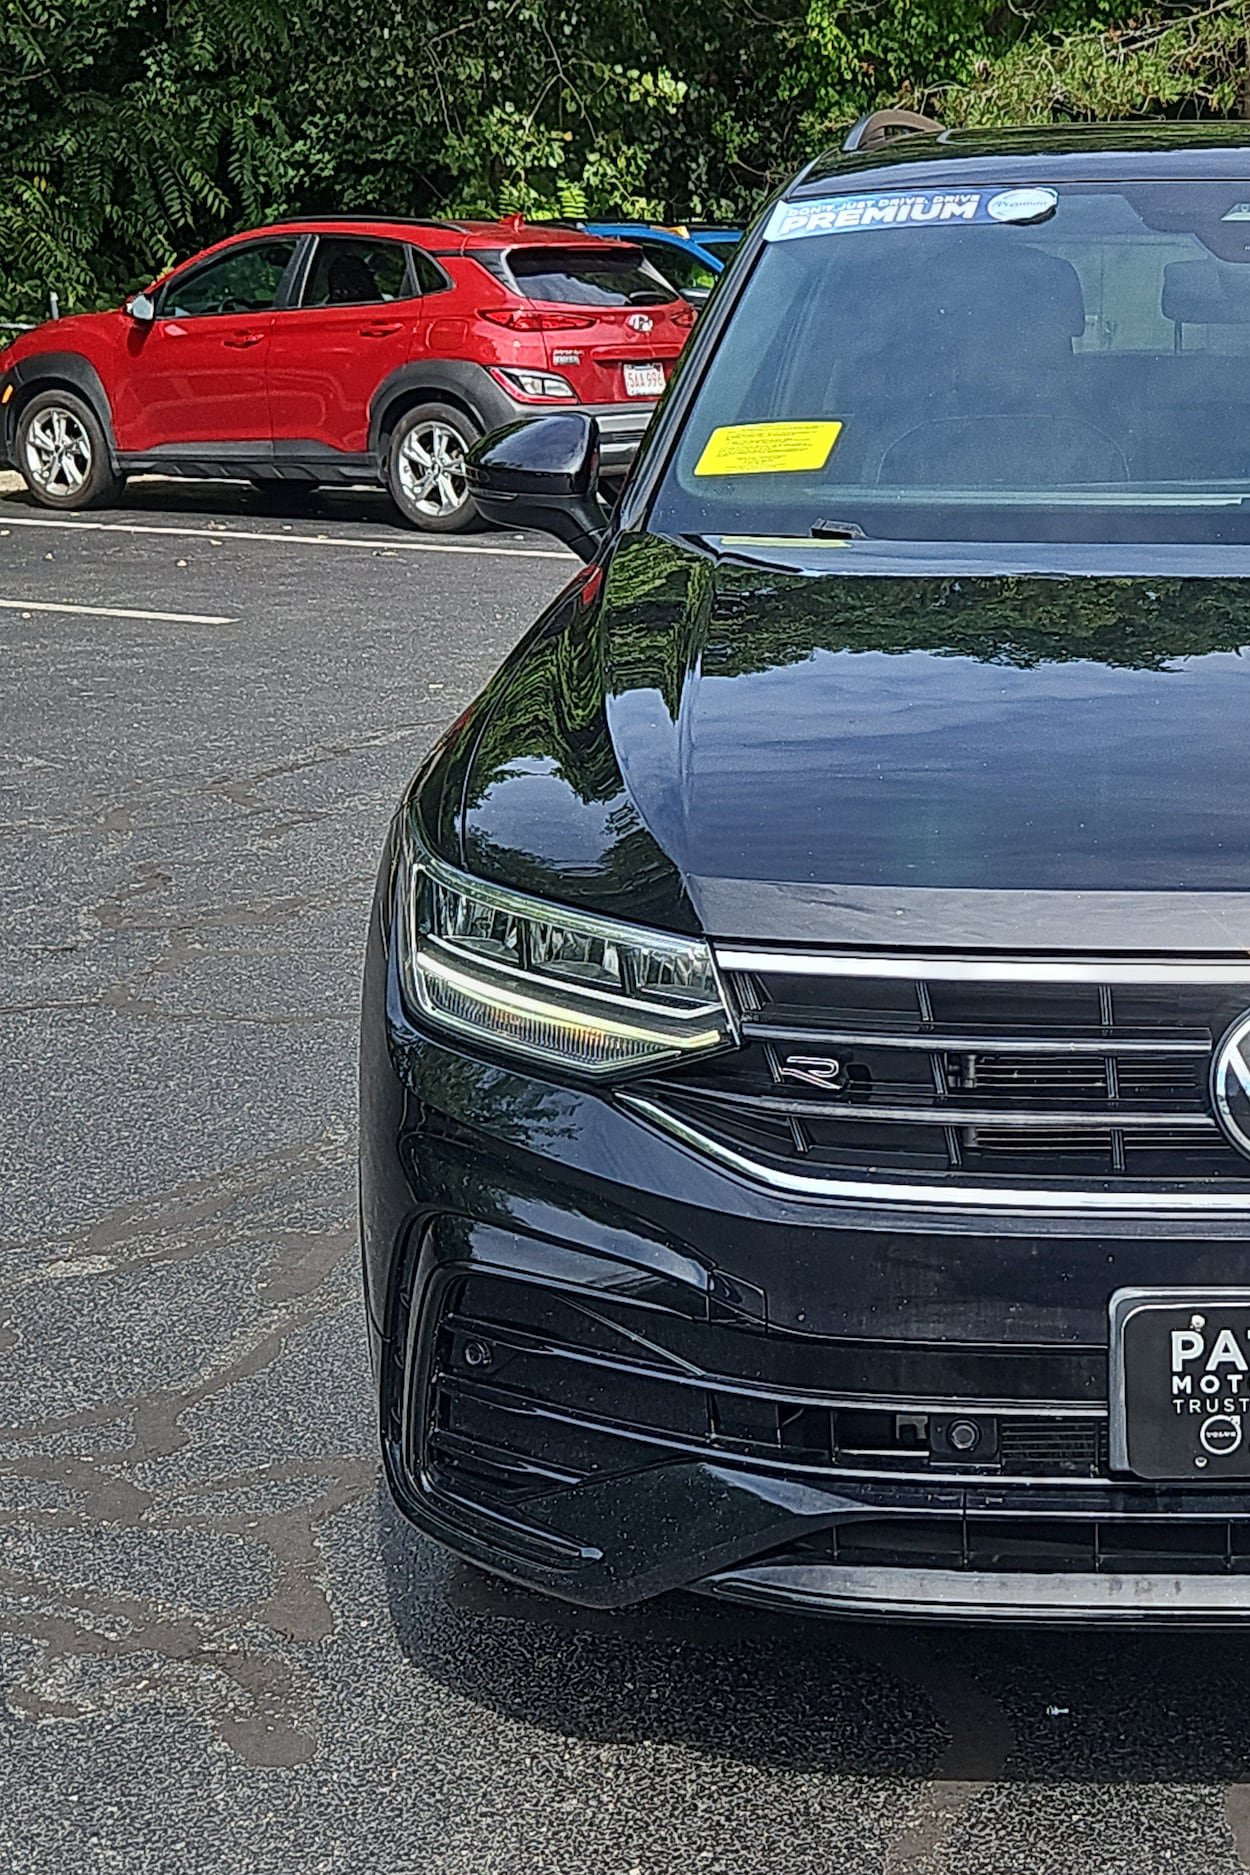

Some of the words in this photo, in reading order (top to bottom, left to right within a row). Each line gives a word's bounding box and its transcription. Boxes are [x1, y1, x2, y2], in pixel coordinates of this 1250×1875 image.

[779, 202, 979, 235] PREMIUM
[787, 203, 834, 216] DON'T
[838, 199, 876, 210] JUST
[932, 194, 981, 204] DRIVE
